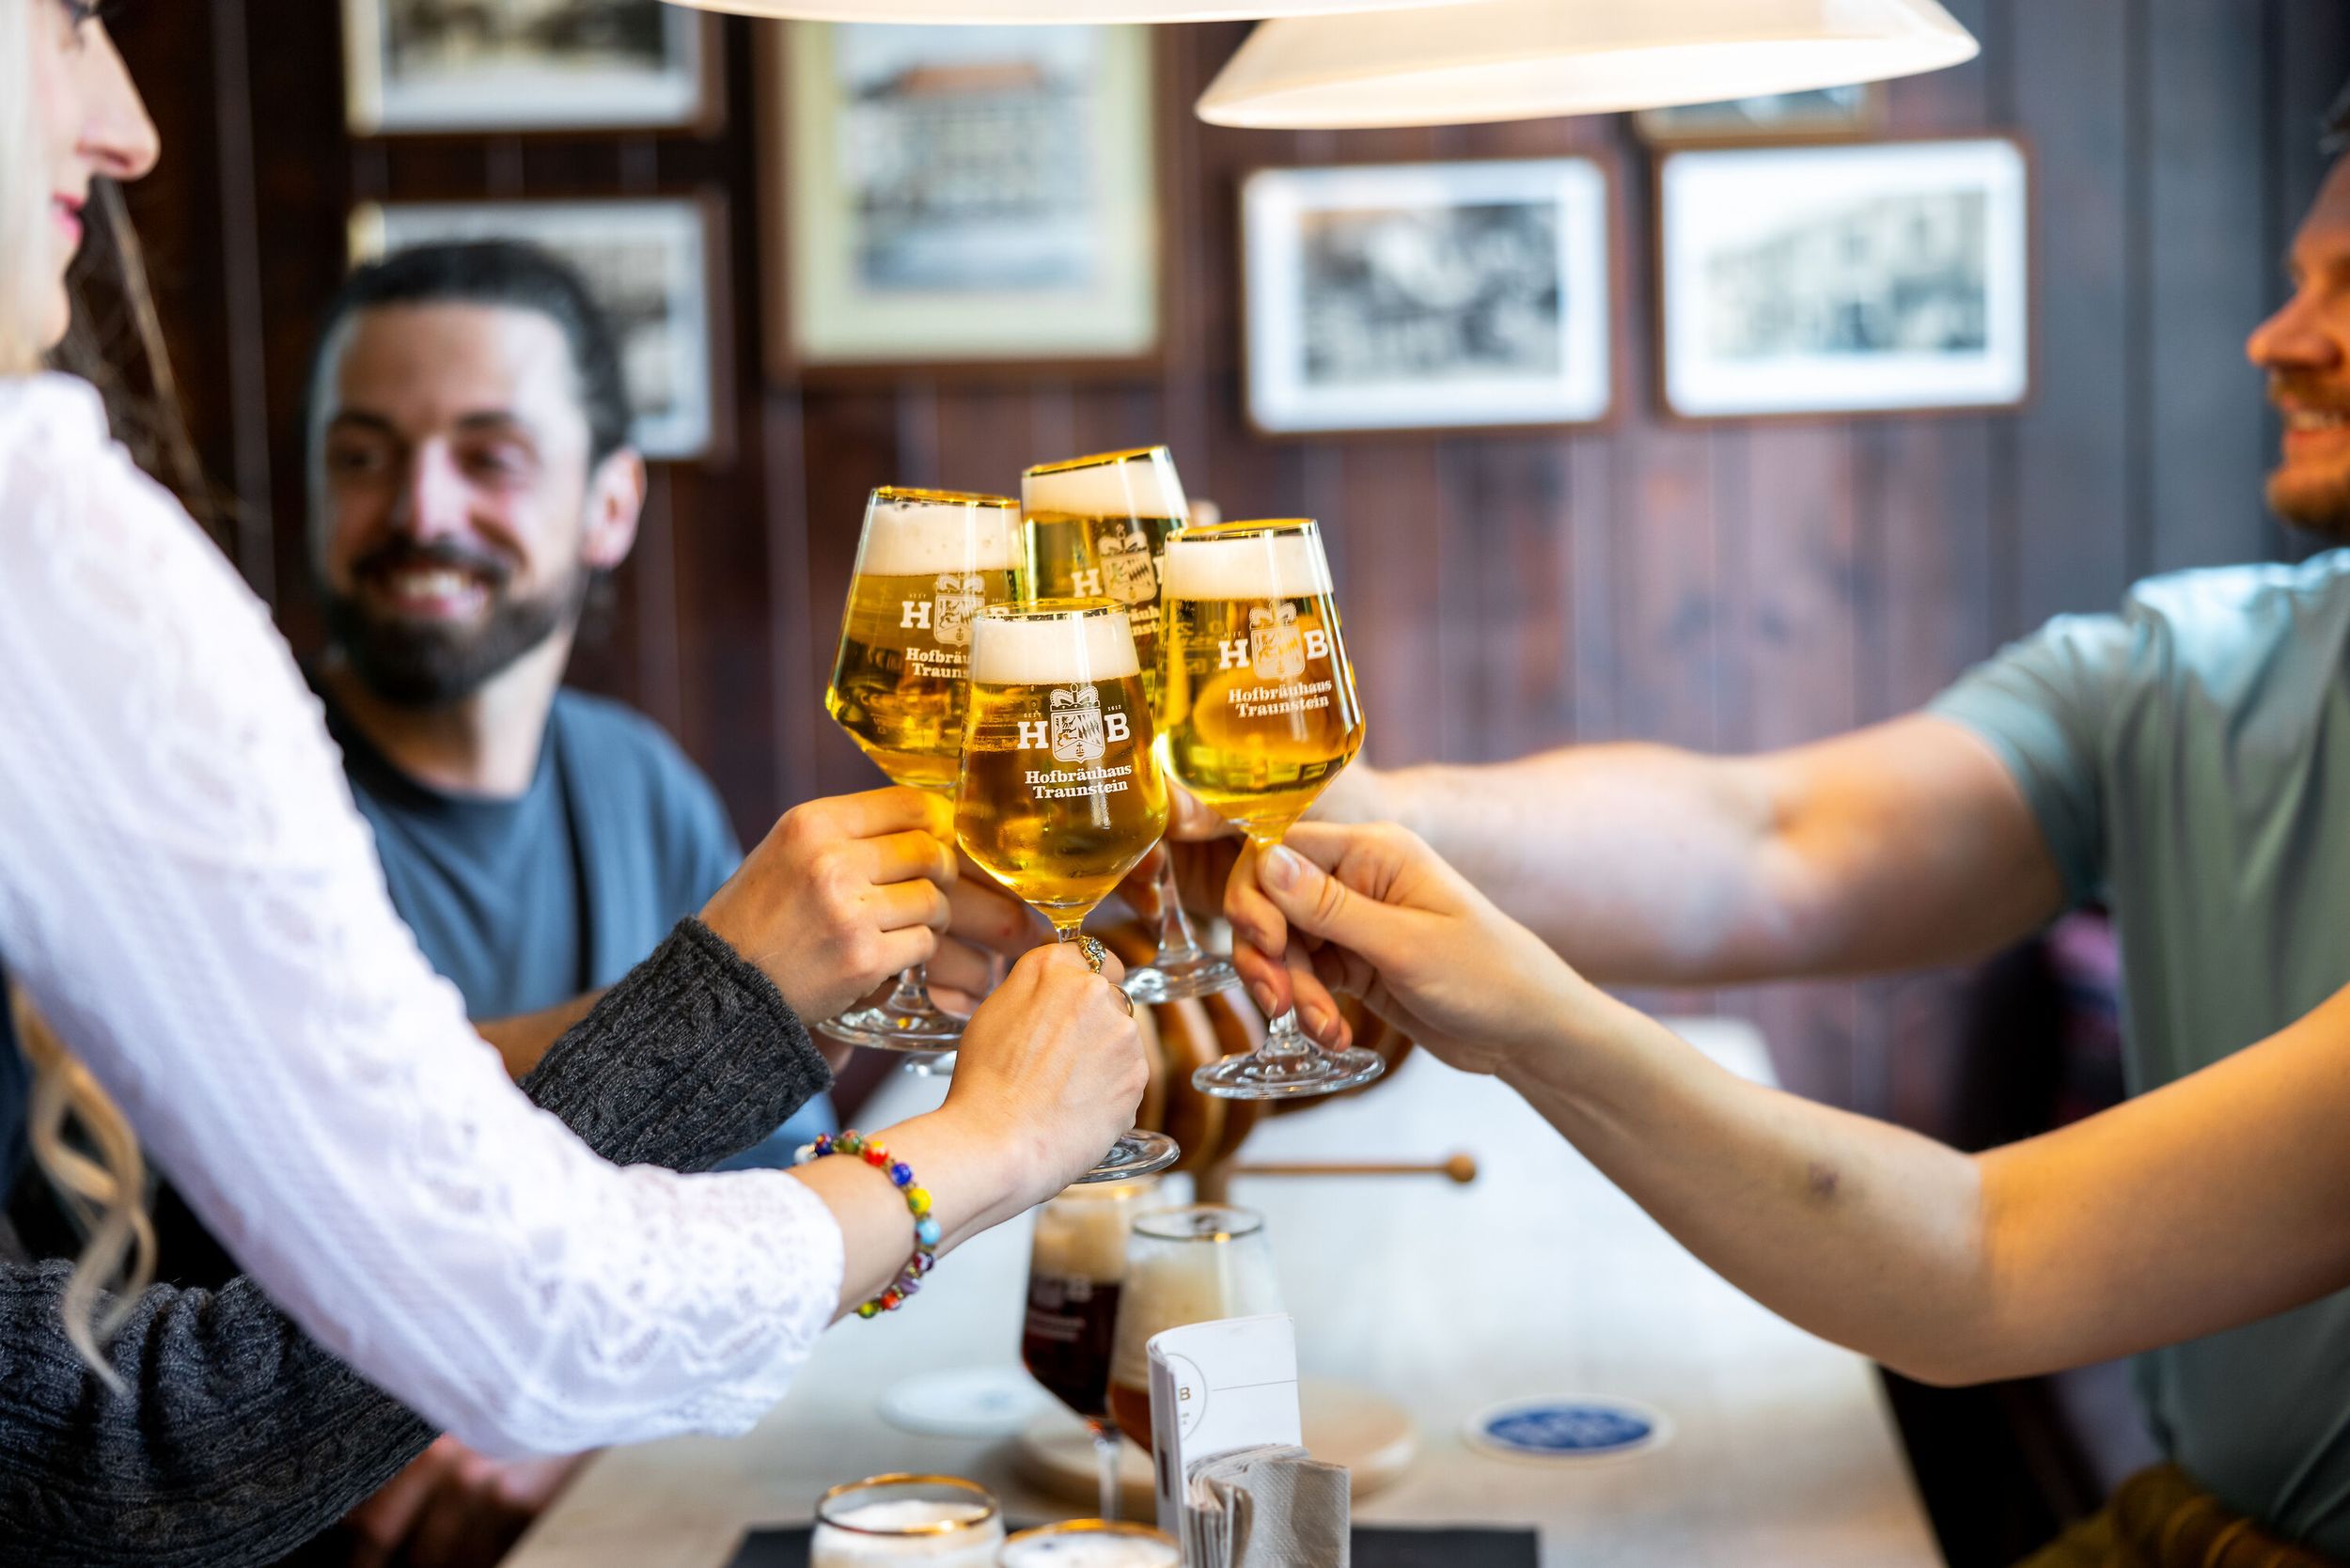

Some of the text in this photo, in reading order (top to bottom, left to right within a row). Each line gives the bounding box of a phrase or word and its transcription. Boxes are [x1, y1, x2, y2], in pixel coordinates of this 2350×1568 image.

[1071, 568, 1103, 598] H
[900, 600, 932, 629] H
[905, 647, 972, 665] Hofbräu
[1218, 629, 1329, 670] H B
[1228, 680, 1333, 704] Hofbräuhaus
[1234, 695, 1330, 718] Traunstein
[1017, 713, 1131, 749] H B
[1025, 764, 1133, 784] Hofbräuhaus
[1032, 779, 1129, 799] Traunstein
[1179, 1387, 1191, 1402] B
